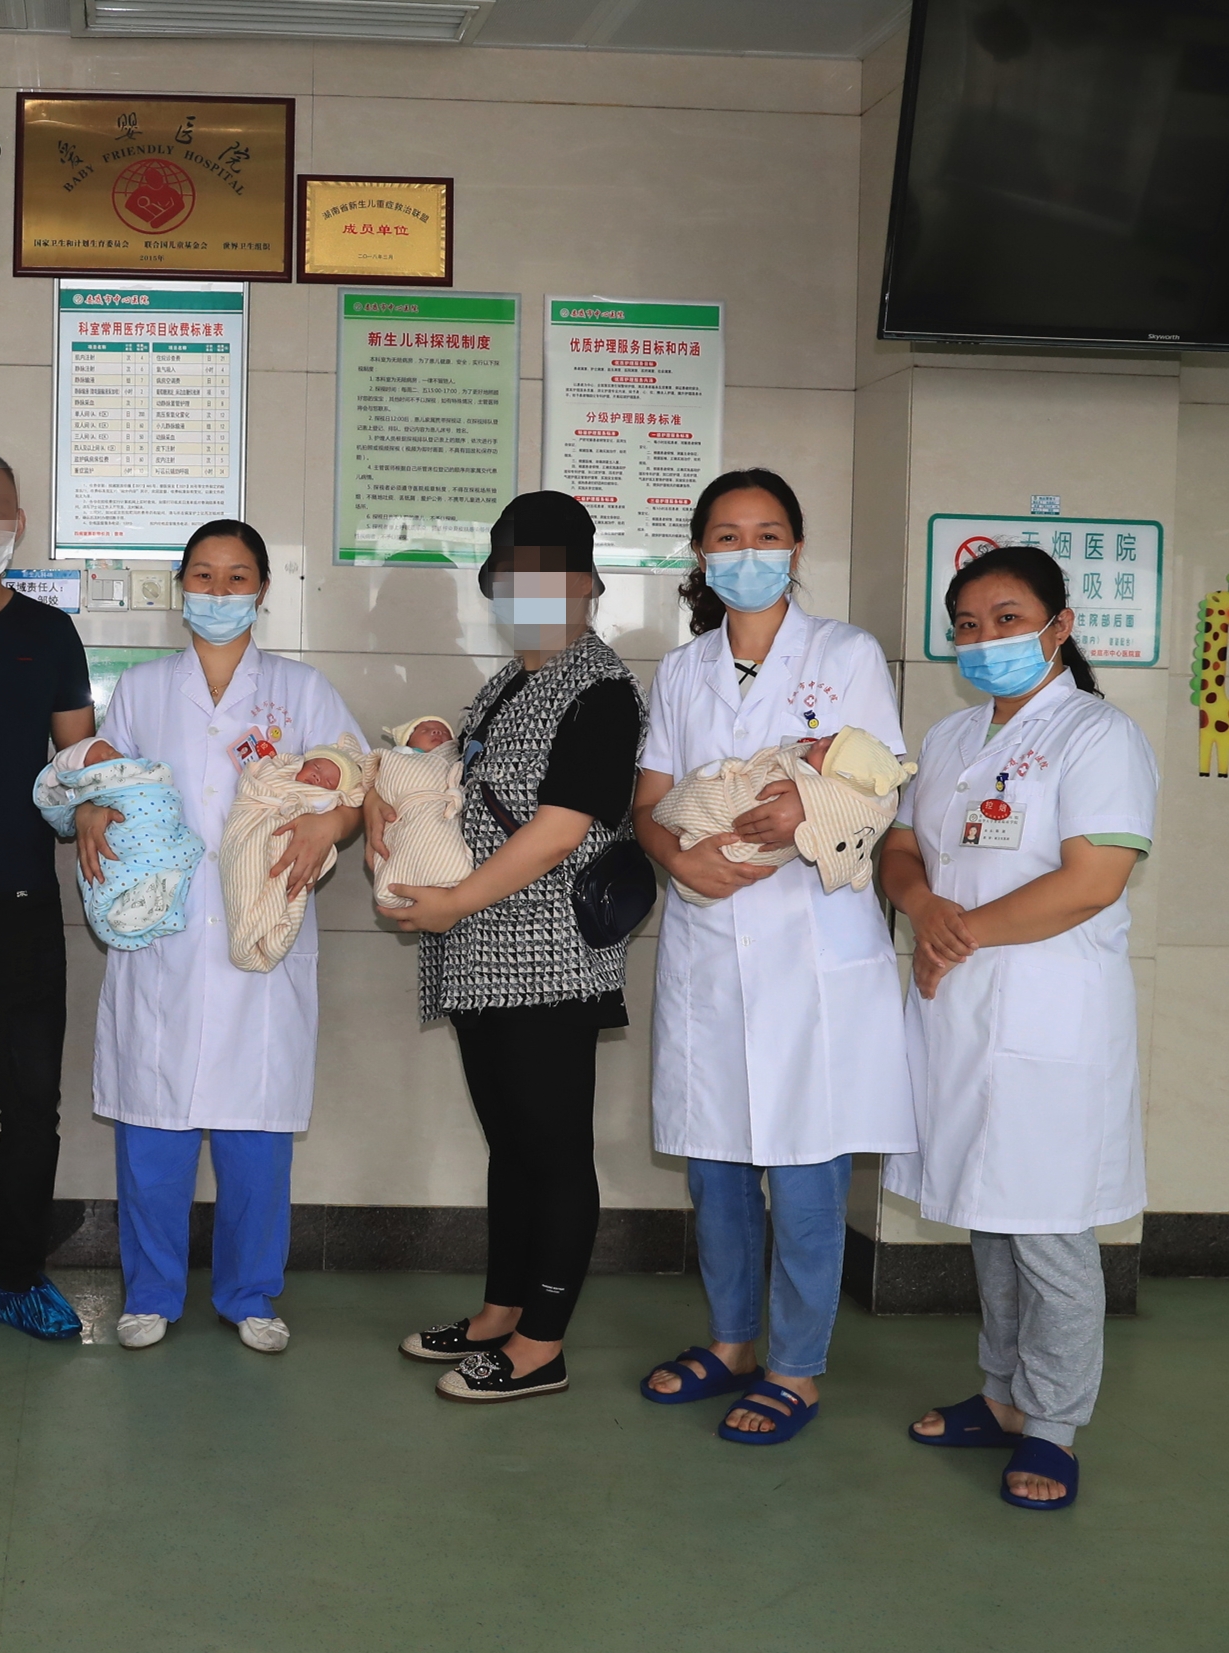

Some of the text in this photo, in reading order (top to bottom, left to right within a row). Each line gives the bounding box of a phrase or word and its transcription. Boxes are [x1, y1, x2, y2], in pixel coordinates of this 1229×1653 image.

[62, 144, 245, 197] BABY FRIENDLY HOSPITAL
[321, 199, 431, 224] 湖南省新生儿重症救治联盟
[341, 223, 410, 237] 成员单位
[33, 238, 271, 251] 国家卫生和计划生育委员会 联合国儿童基金会 世界卫生组织
[139, 254, 165, 262] 2015年
[78, 321, 224, 337] 科室常用医疗项目收费标准表
[368, 332, 491, 350] 新生儿科探视制度
[1148, 333, 1181, 341] Skyworth
[570, 338, 701, 356] 优质护理服务目标和内涵
[586, 412, 682, 425] 分级护理服务标准
[1066, 572, 1135, 601] 吸烟
[1078, 613, 1134, 628] 住院部后面
